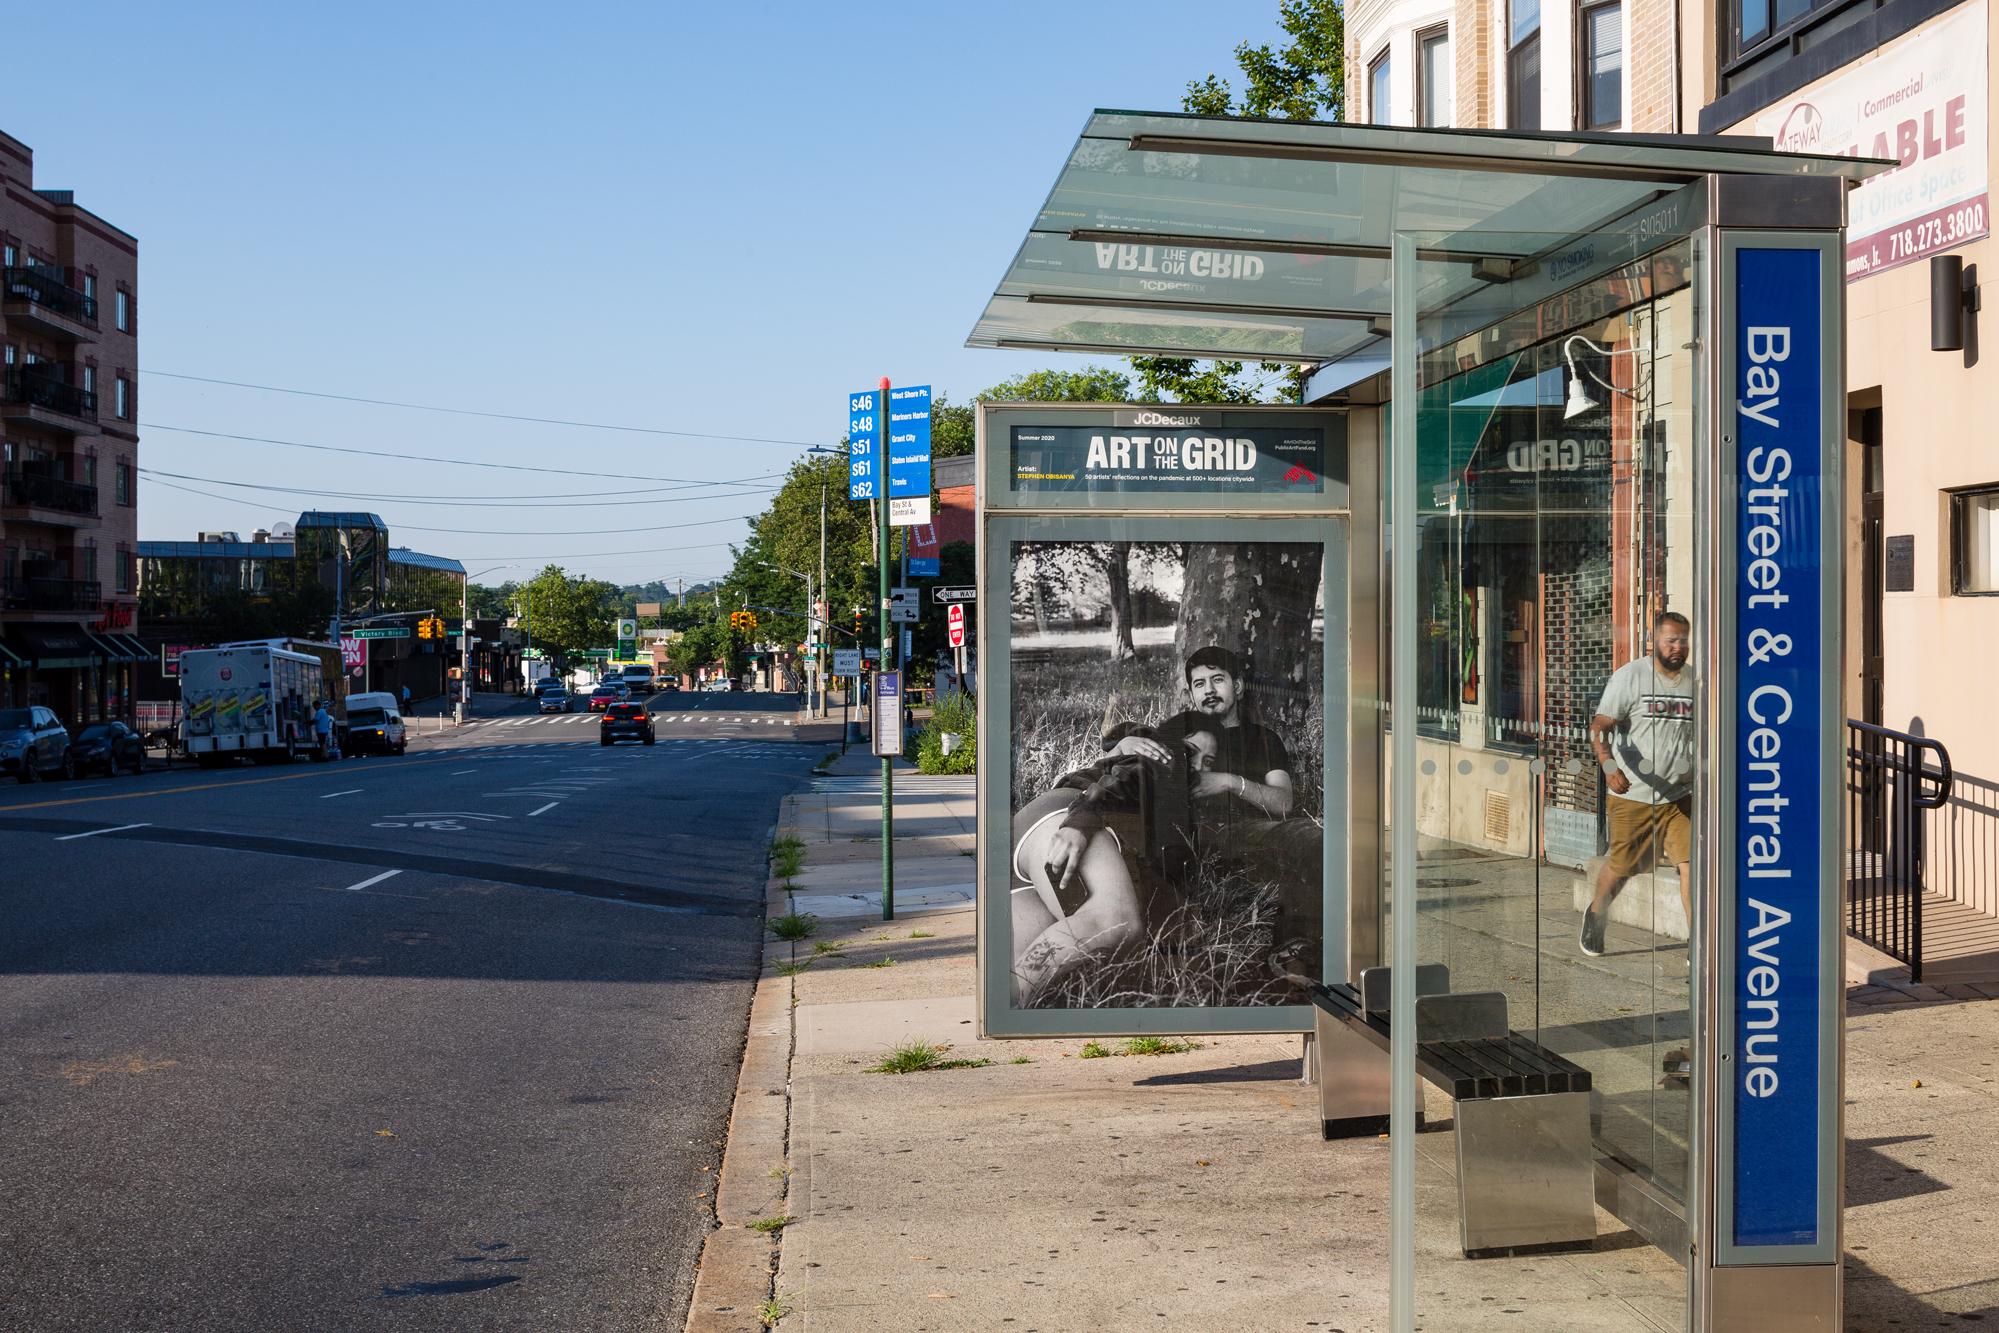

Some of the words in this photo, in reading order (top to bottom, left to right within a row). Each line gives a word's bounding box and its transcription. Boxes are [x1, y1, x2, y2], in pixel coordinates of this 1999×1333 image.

[1863, 72, 1924, 118] Commercial
[1839, 130, 1853, 145] CORP
[1850, 195, 1864, 225] of
[1870, 183, 1913, 216] Office
[1920, 164, 1967, 202] Space
[1872, 245, 1881, 267] Jr.
[1890, 204, 1983, 261] 718.273.3800
[1558, 256, 1567, 275] NO
[1567, 243, 1594, 270] SMOKING
[1737, 326, 1791, 428] Bay
[892, 391, 904, 400] West
[904, 390, 919, 399] Shore
[892, 413, 912, 421] Mariners
[912, 411, 929, 419] Harbor
[1134, 413, 1201, 426] JCDecaux
[892, 435, 906, 443] Grant
[906, 434, 916, 443] City
[1154, 437, 1178, 455] ON
[892, 456, 905, 465] Staten
[905, 455, 919, 464] Island
[1086, 436, 1151, 469] ART
[1181, 437, 1257, 471] GRID
[1153, 456, 1179, 470] THE
[1283, 460, 1303, 482] PUBLIC
[892, 478, 907, 486] Travis
[1291, 469, 1304, 483] ART
[1301, 465, 1316, 482] FUND
[892, 501, 901, 509] Bay
[1747, 446, 1792, 609] Street
[113, 602, 133, 628] Food
[952, 630, 961, 639] ENTER
[1747, 628, 1793, 667] &
[1747, 684, 1793, 878] Central
[1745, 897, 1791, 1098] Avenue
